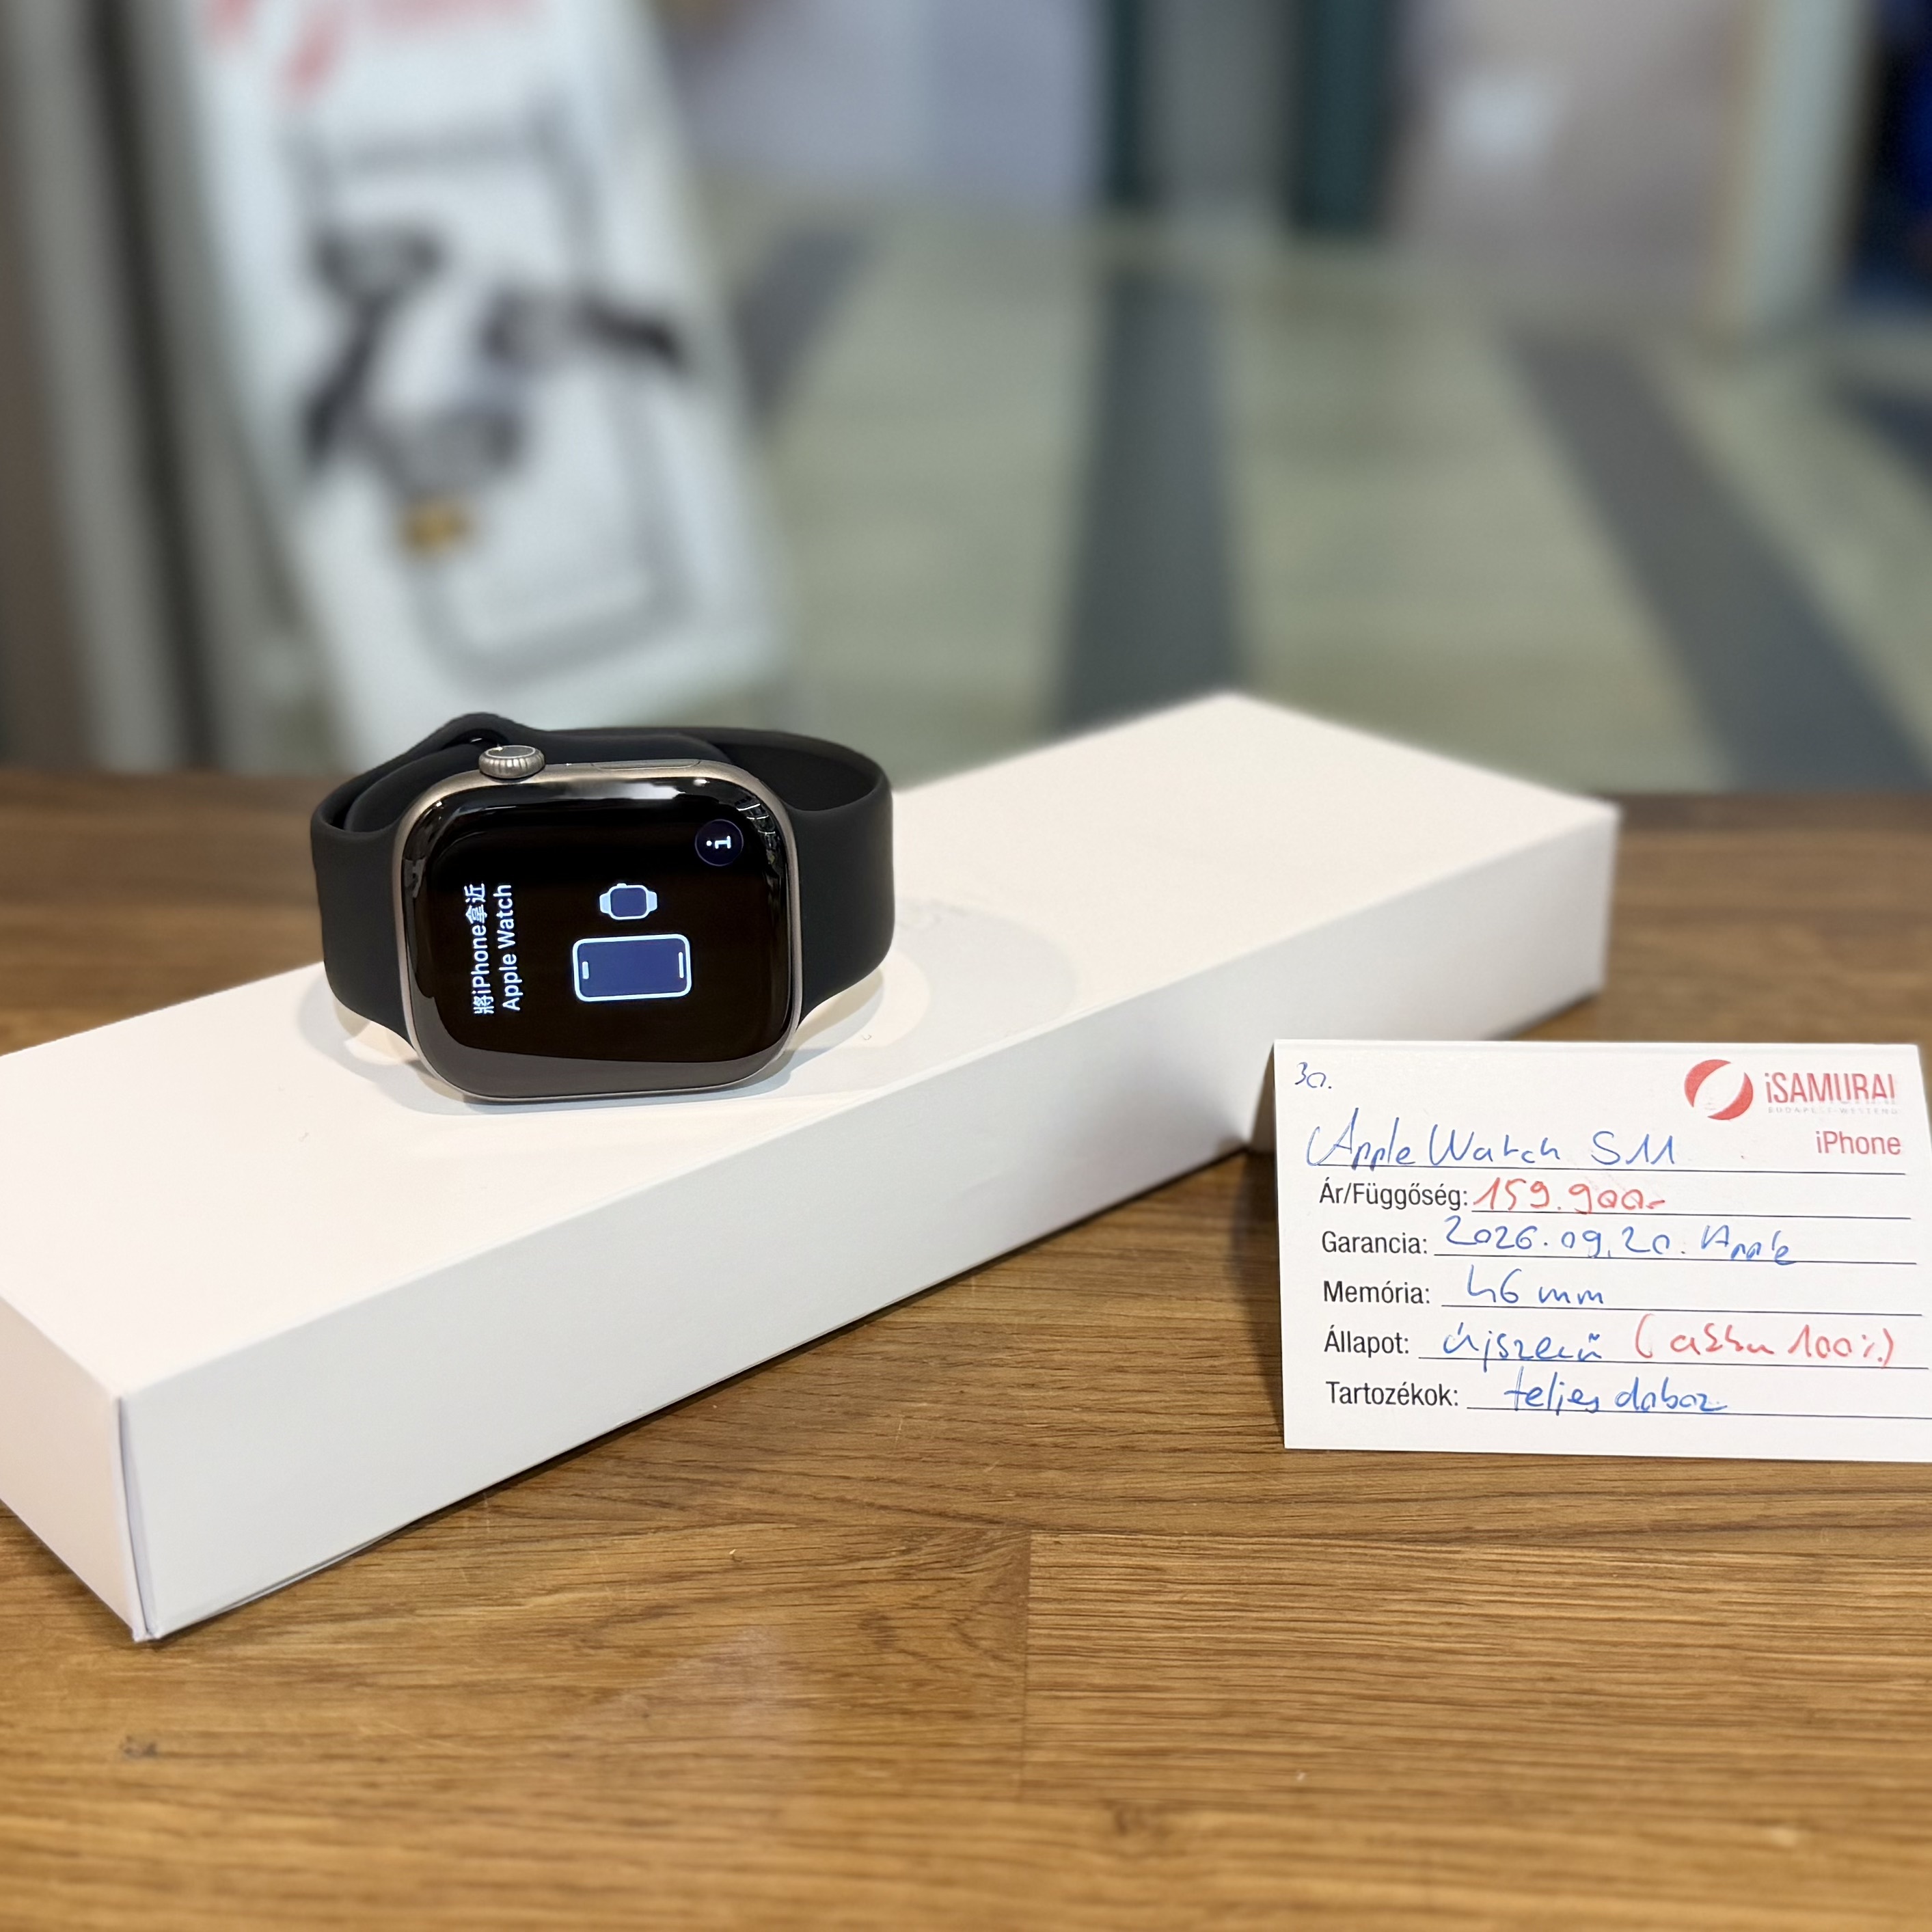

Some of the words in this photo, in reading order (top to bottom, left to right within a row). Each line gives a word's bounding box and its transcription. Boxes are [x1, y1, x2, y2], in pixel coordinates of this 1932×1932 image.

[493, 884, 516, 950] Watch
[463, 882, 495, 1014] 將iPhone拿近
[498, 953, 523, 1011] Apple
[1764, 1072, 1896, 1104] iSAMURAI
[1306, 1107, 1416, 1171] Apple
[1428, 1124, 1561, 1166] Watch
[1815, 1130, 1901, 1155] iPhone
[1319, 1177, 1469, 1211] Ár/Függőség:
[1322, 1231, 1428, 1254] Garancia:
[1323, 1280, 1430, 1304] Memória:
[1467, 1264, 1523, 1304] 46
[1324, 1324, 1409, 1357] Állapot:
[1326, 1380, 1459, 1406] Tartozékok:
